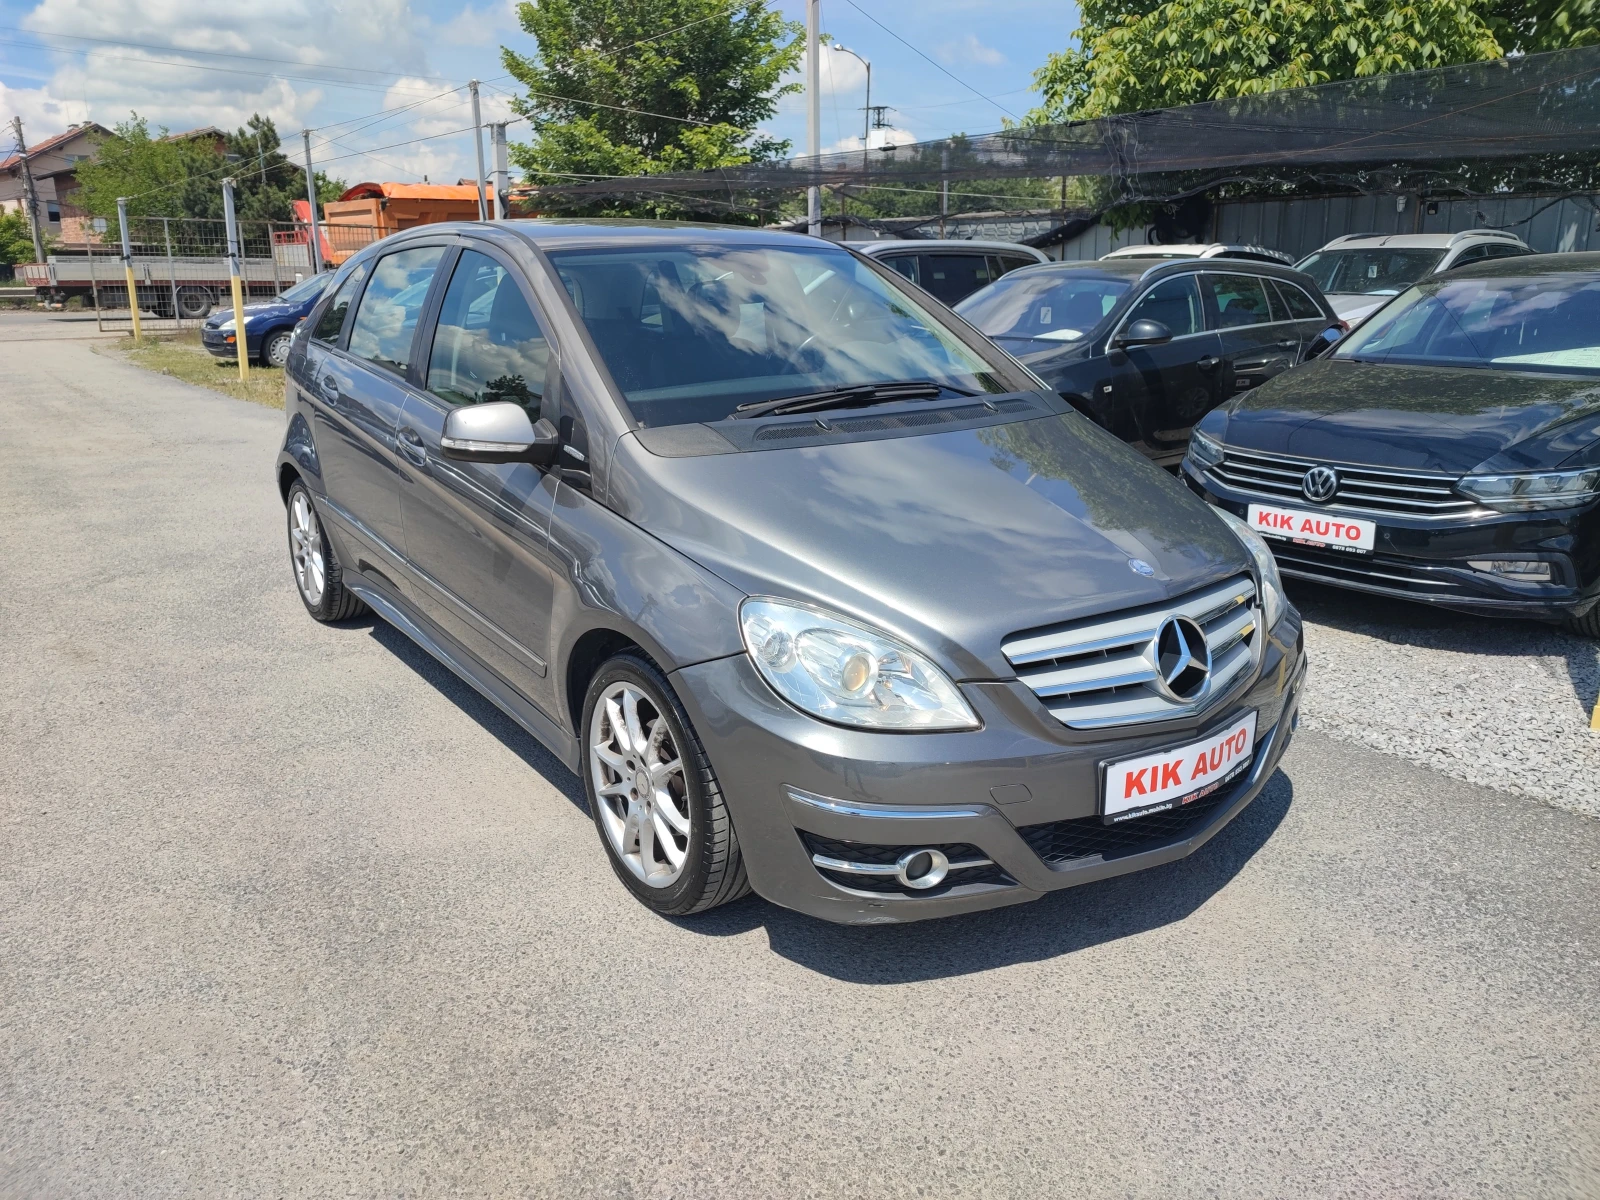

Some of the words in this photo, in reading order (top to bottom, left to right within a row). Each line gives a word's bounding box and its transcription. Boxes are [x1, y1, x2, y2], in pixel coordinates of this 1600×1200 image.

[1258, 511, 1294, 531] KIK
[1300, 518, 1361, 541] AUTO
[1124, 759, 1184, 799] KIK
[1191, 728, 1247, 781] AUTO
[1181, 792, 1199, 805] KIK
